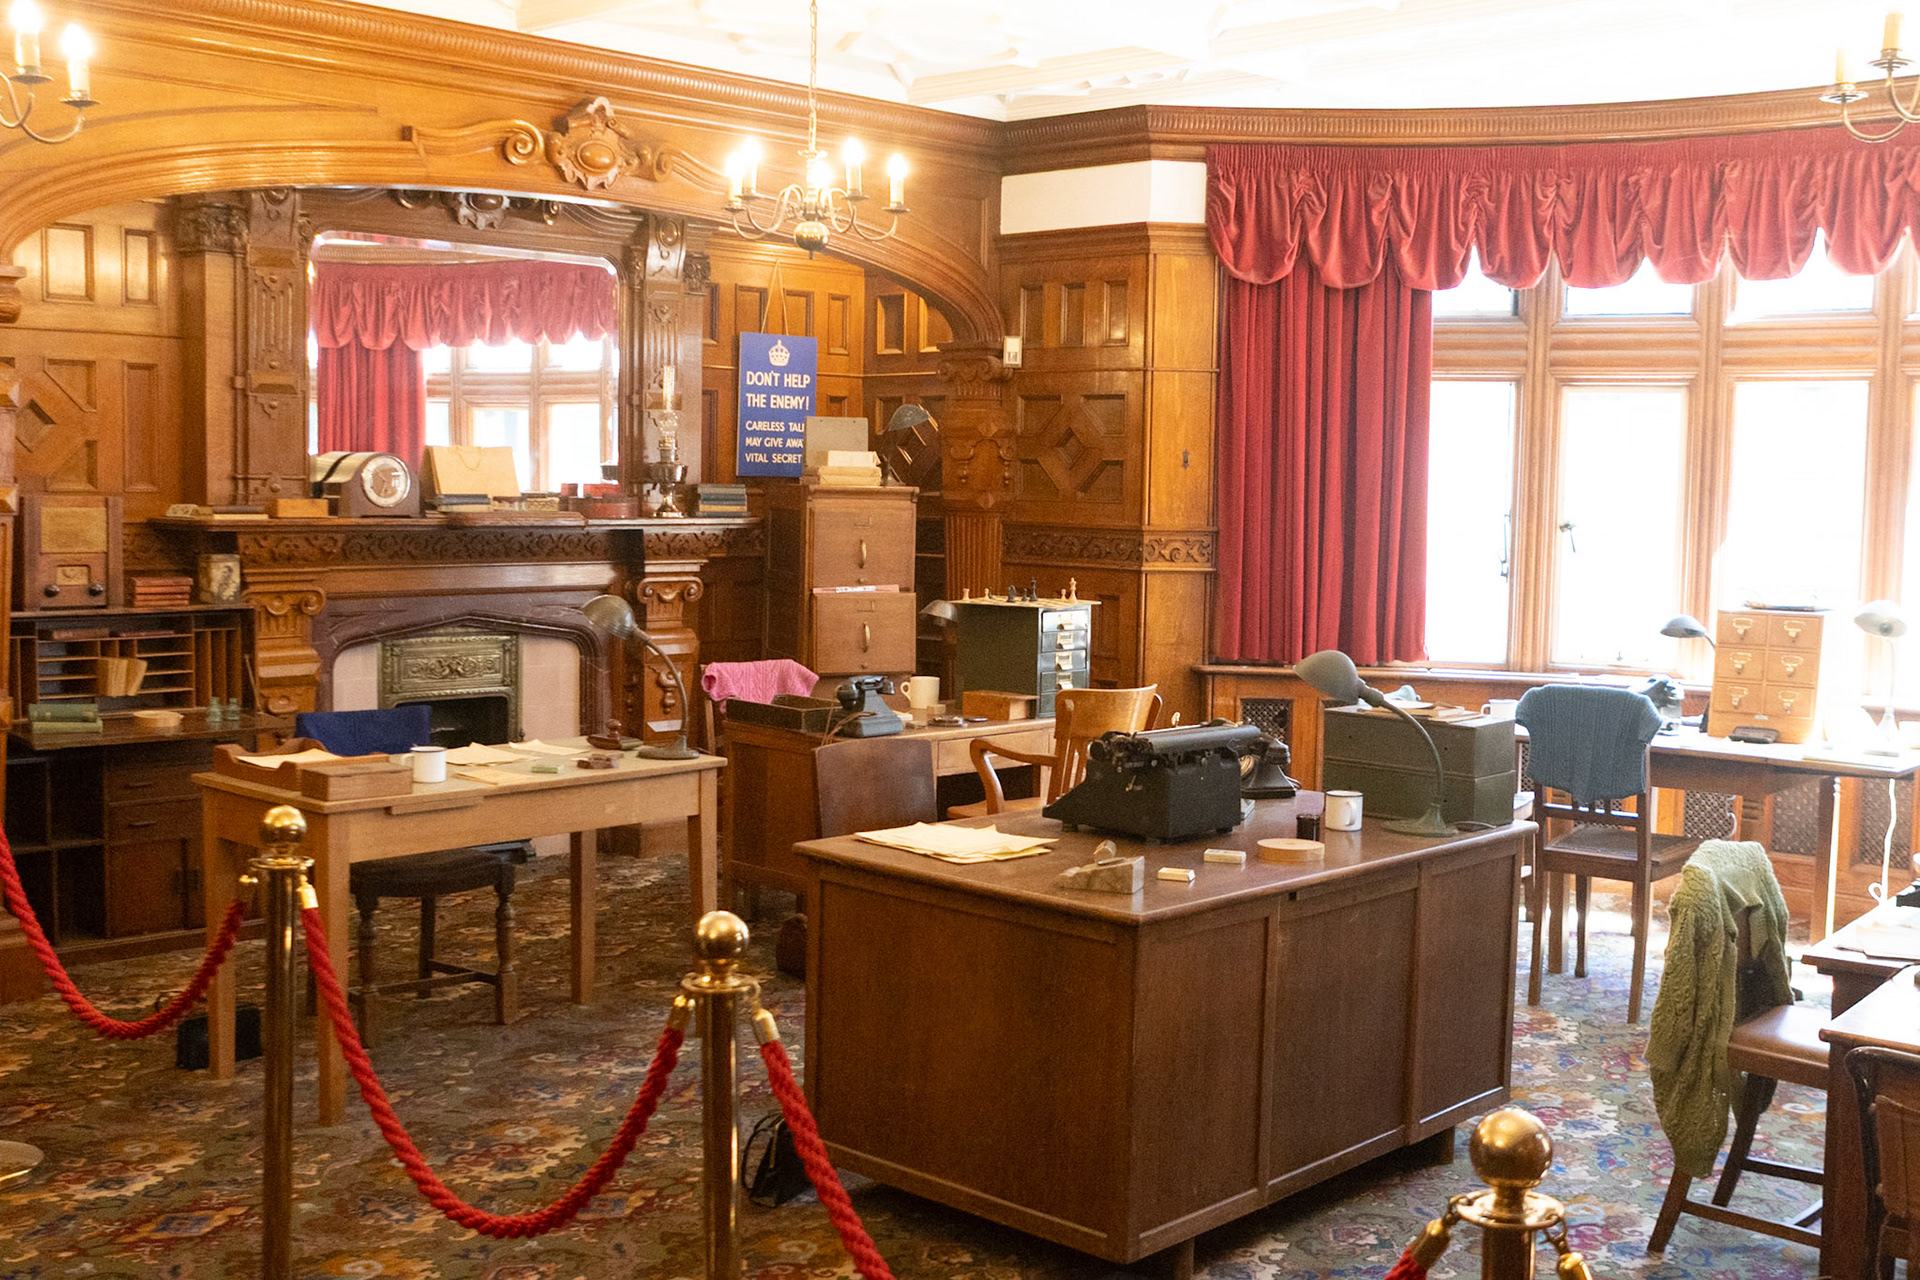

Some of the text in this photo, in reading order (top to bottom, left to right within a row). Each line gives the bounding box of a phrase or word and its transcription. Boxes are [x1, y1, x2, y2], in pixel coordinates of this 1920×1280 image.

[746, 370, 811, 388] DON'T HELP
[746, 393, 810, 410] THE ENEMY!
[745, 420, 785, 432] CARELESS
[745, 437, 804, 448] MAY GIVE AWA
[745, 453, 803, 464] VITAL SECRET
